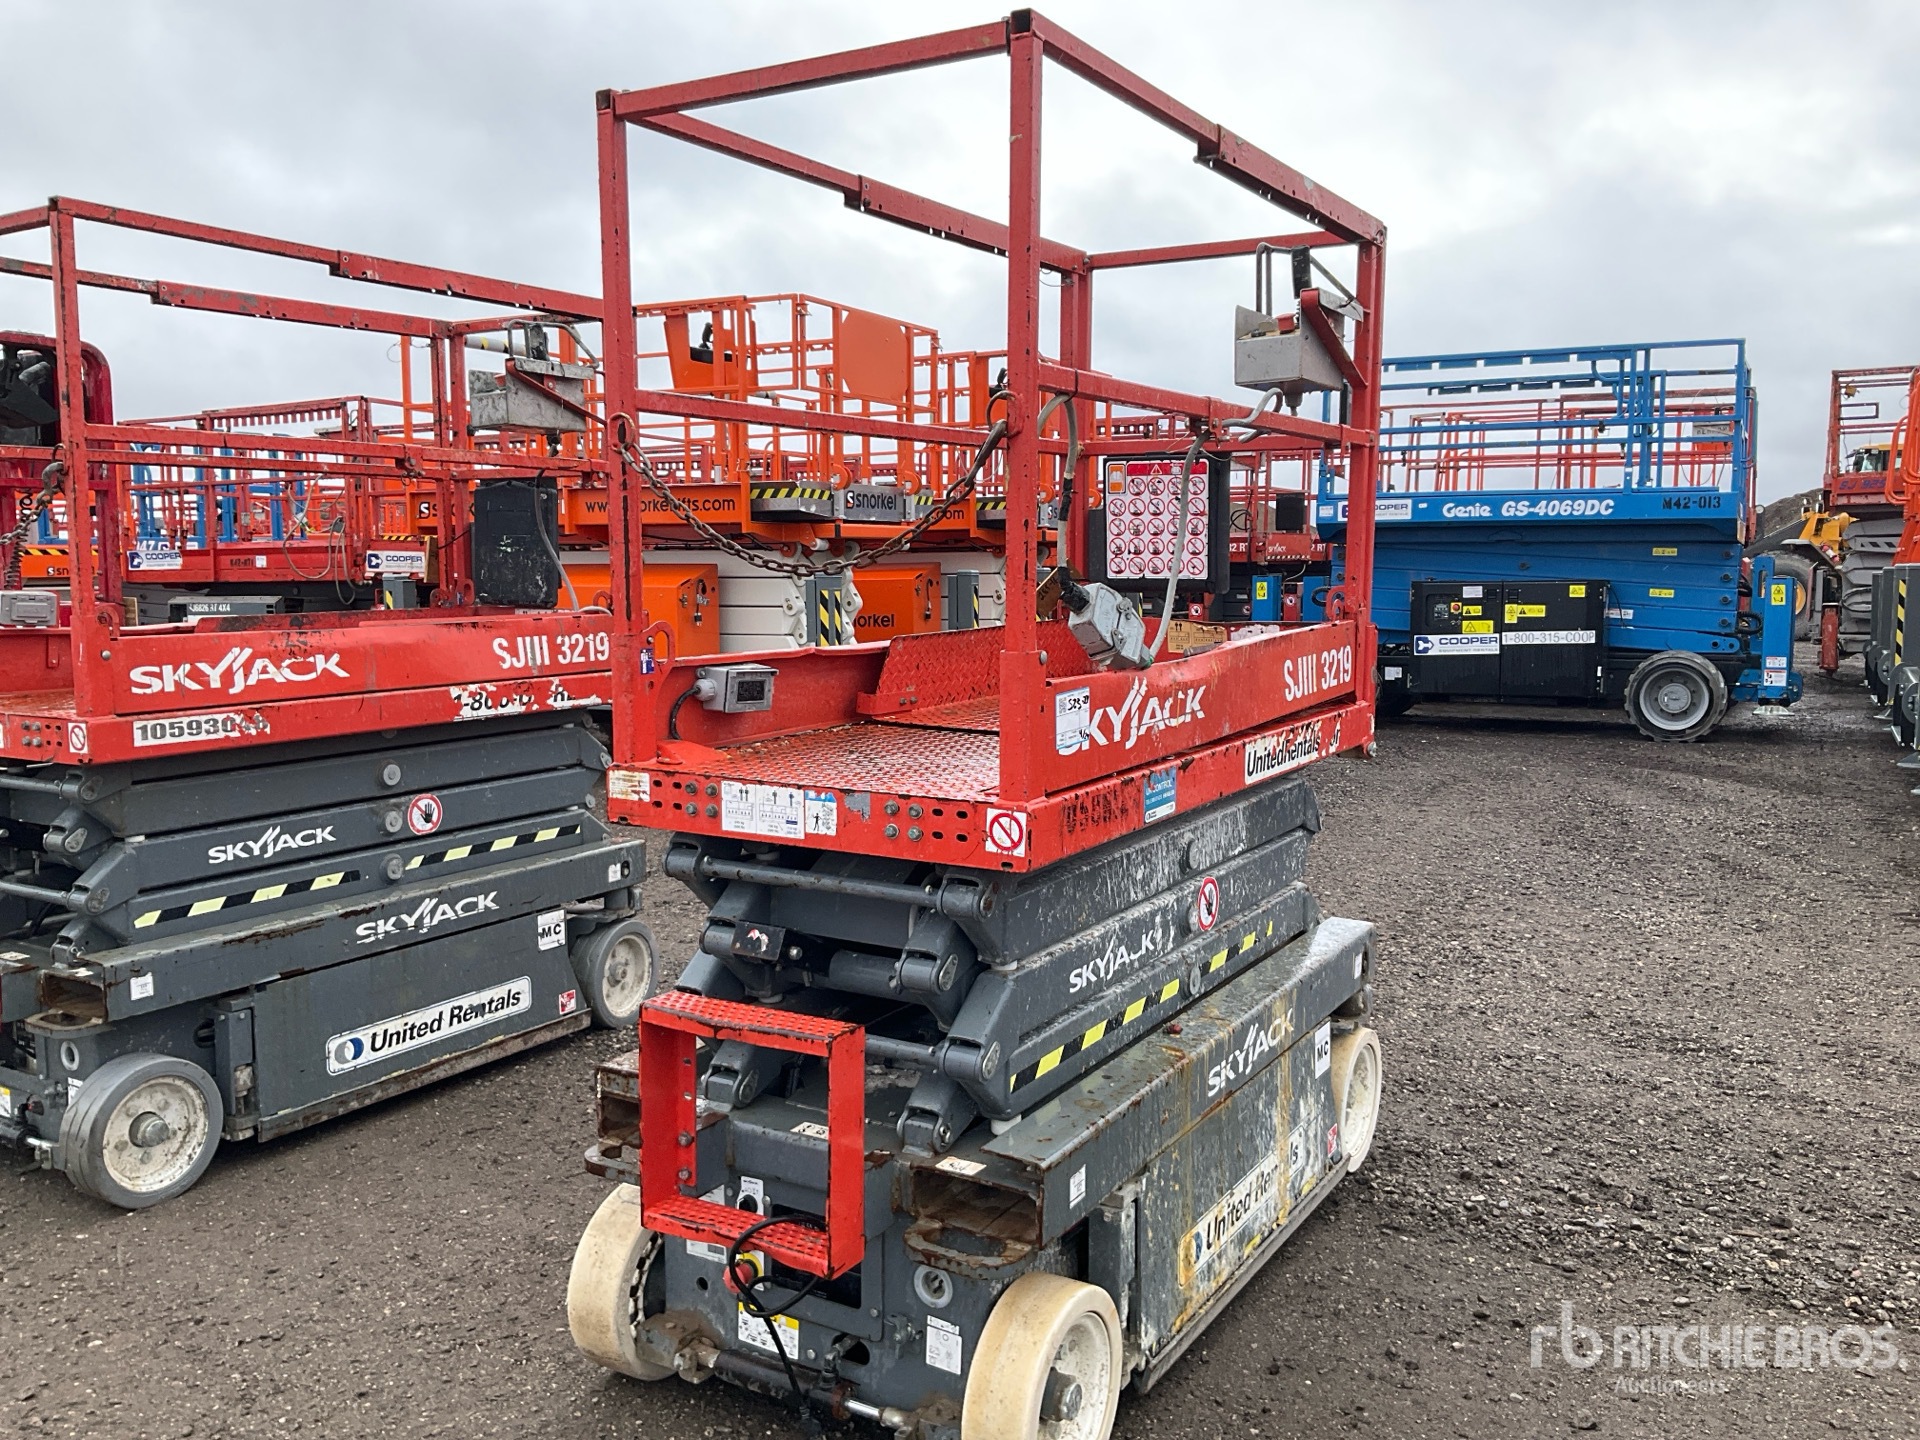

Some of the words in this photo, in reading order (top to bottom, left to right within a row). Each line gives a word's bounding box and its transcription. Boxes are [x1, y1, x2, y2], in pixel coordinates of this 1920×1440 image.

[1860, 479, 1887, 491] 925
[856, 491, 897, 510] snorkel
[1374, 503, 1409, 511] OPER
[1442, 502, 1493, 518] Genie
[1501, 499, 1615, 517] GS-4069DC
[1662, 495, 1722, 510] M42-013
[145, 552, 182, 560] COOPER
[385, 554, 423, 563] COOPER
[853, 613, 896, 628] orkel
[1438, 636, 1499, 646] COOPER
[1503, 631, 1594, 643] 1-800-315-COOP
[492, 635, 551, 669] SJIII
[556, 631, 610, 665] 3219
[129, 646, 351, 695] SKYJACK
[1283, 656, 1318, 702] SJIII
[1320, 644, 1352, 691] 3219
[208, 825, 337, 864] SKYJACK
[356, 890, 500, 945] SKYJACK
[370, 1010, 444, 1053] United
[448, 988, 522, 1028] Rentals
[1207, 1007, 1295, 1098] SKYJACK
[1316, 1040, 1330, 1063] MC
[1205, 1189, 1252, 1251] United
